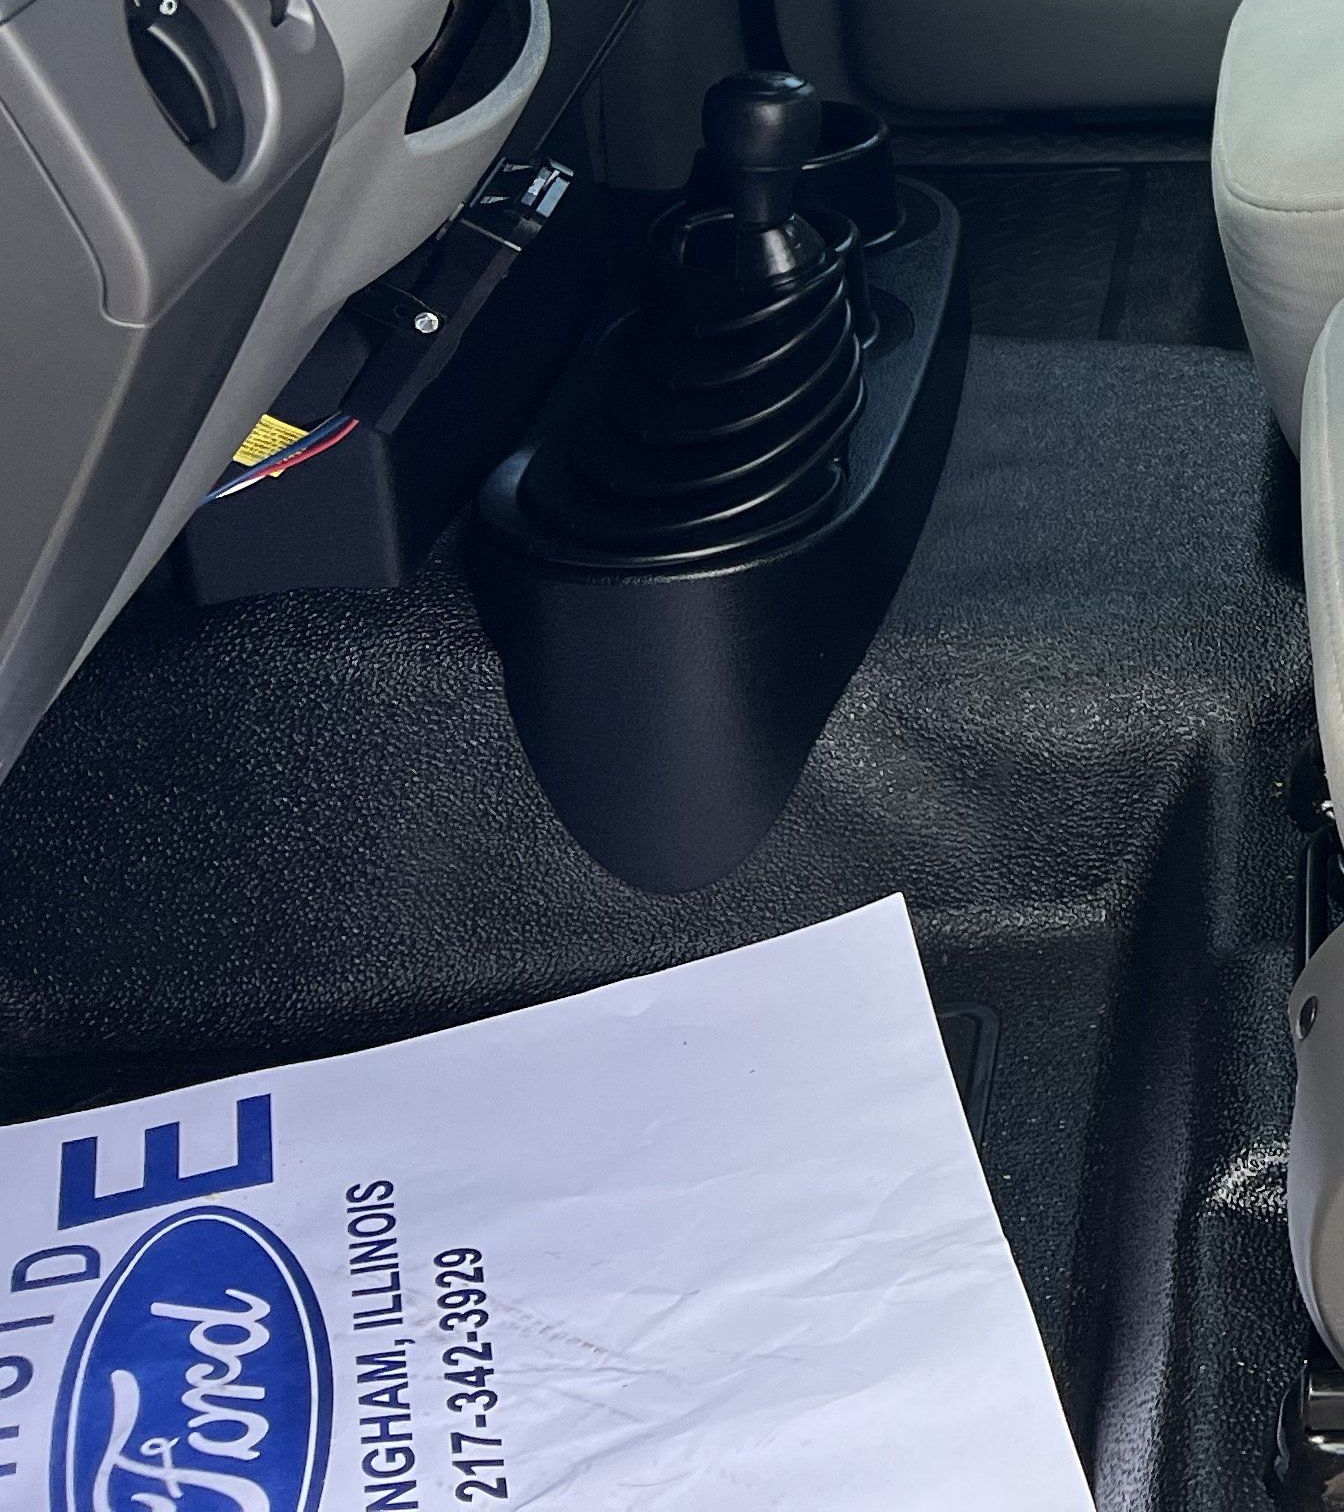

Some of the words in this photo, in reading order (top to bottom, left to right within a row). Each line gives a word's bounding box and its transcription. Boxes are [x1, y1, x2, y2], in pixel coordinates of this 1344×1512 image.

[346, 1179, 403, 1331] ILLINOIS
[93, 1289, 271, 1512] Ford
[433, 1247, 508, 1503] 217-342-3929
